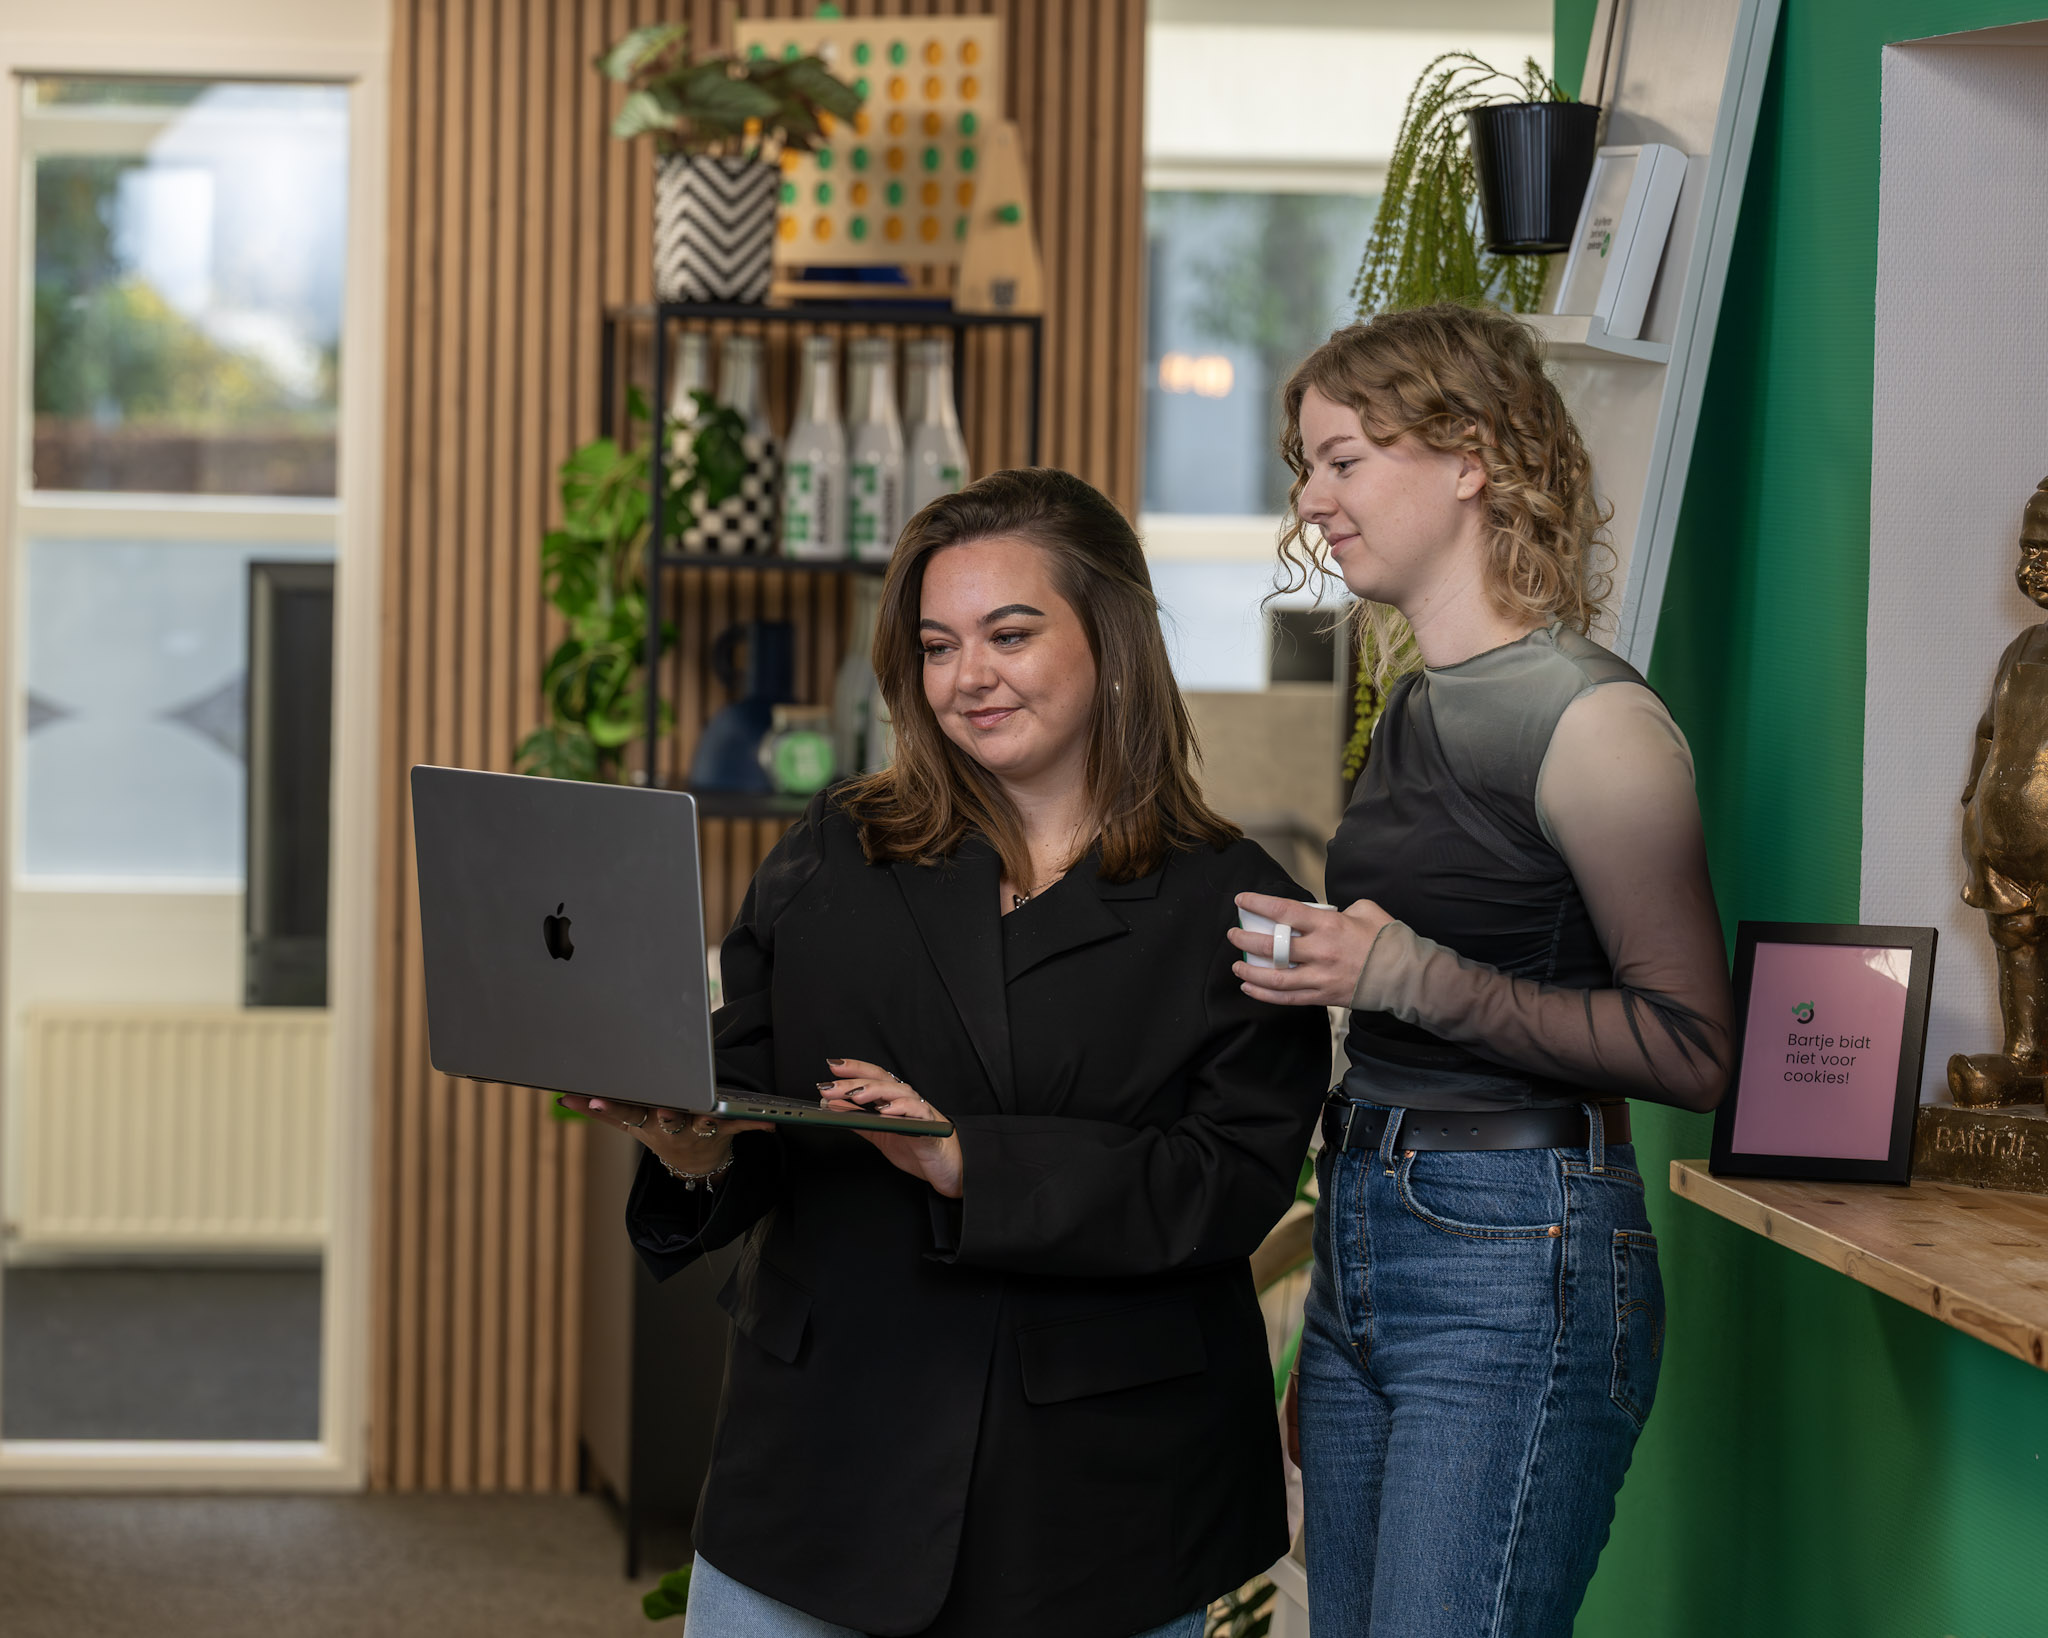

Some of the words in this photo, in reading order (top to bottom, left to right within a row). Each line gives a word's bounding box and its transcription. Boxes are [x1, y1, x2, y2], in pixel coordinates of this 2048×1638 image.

[1788, 1033, 1834, 1051] Bartje
[1839, 1035, 1871, 1049] bidt
[1785, 1051, 1816, 1065] niet
[1820, 1055, 1857, 1067] voor
[1783, 1070, 1849, 1085] cookies!
